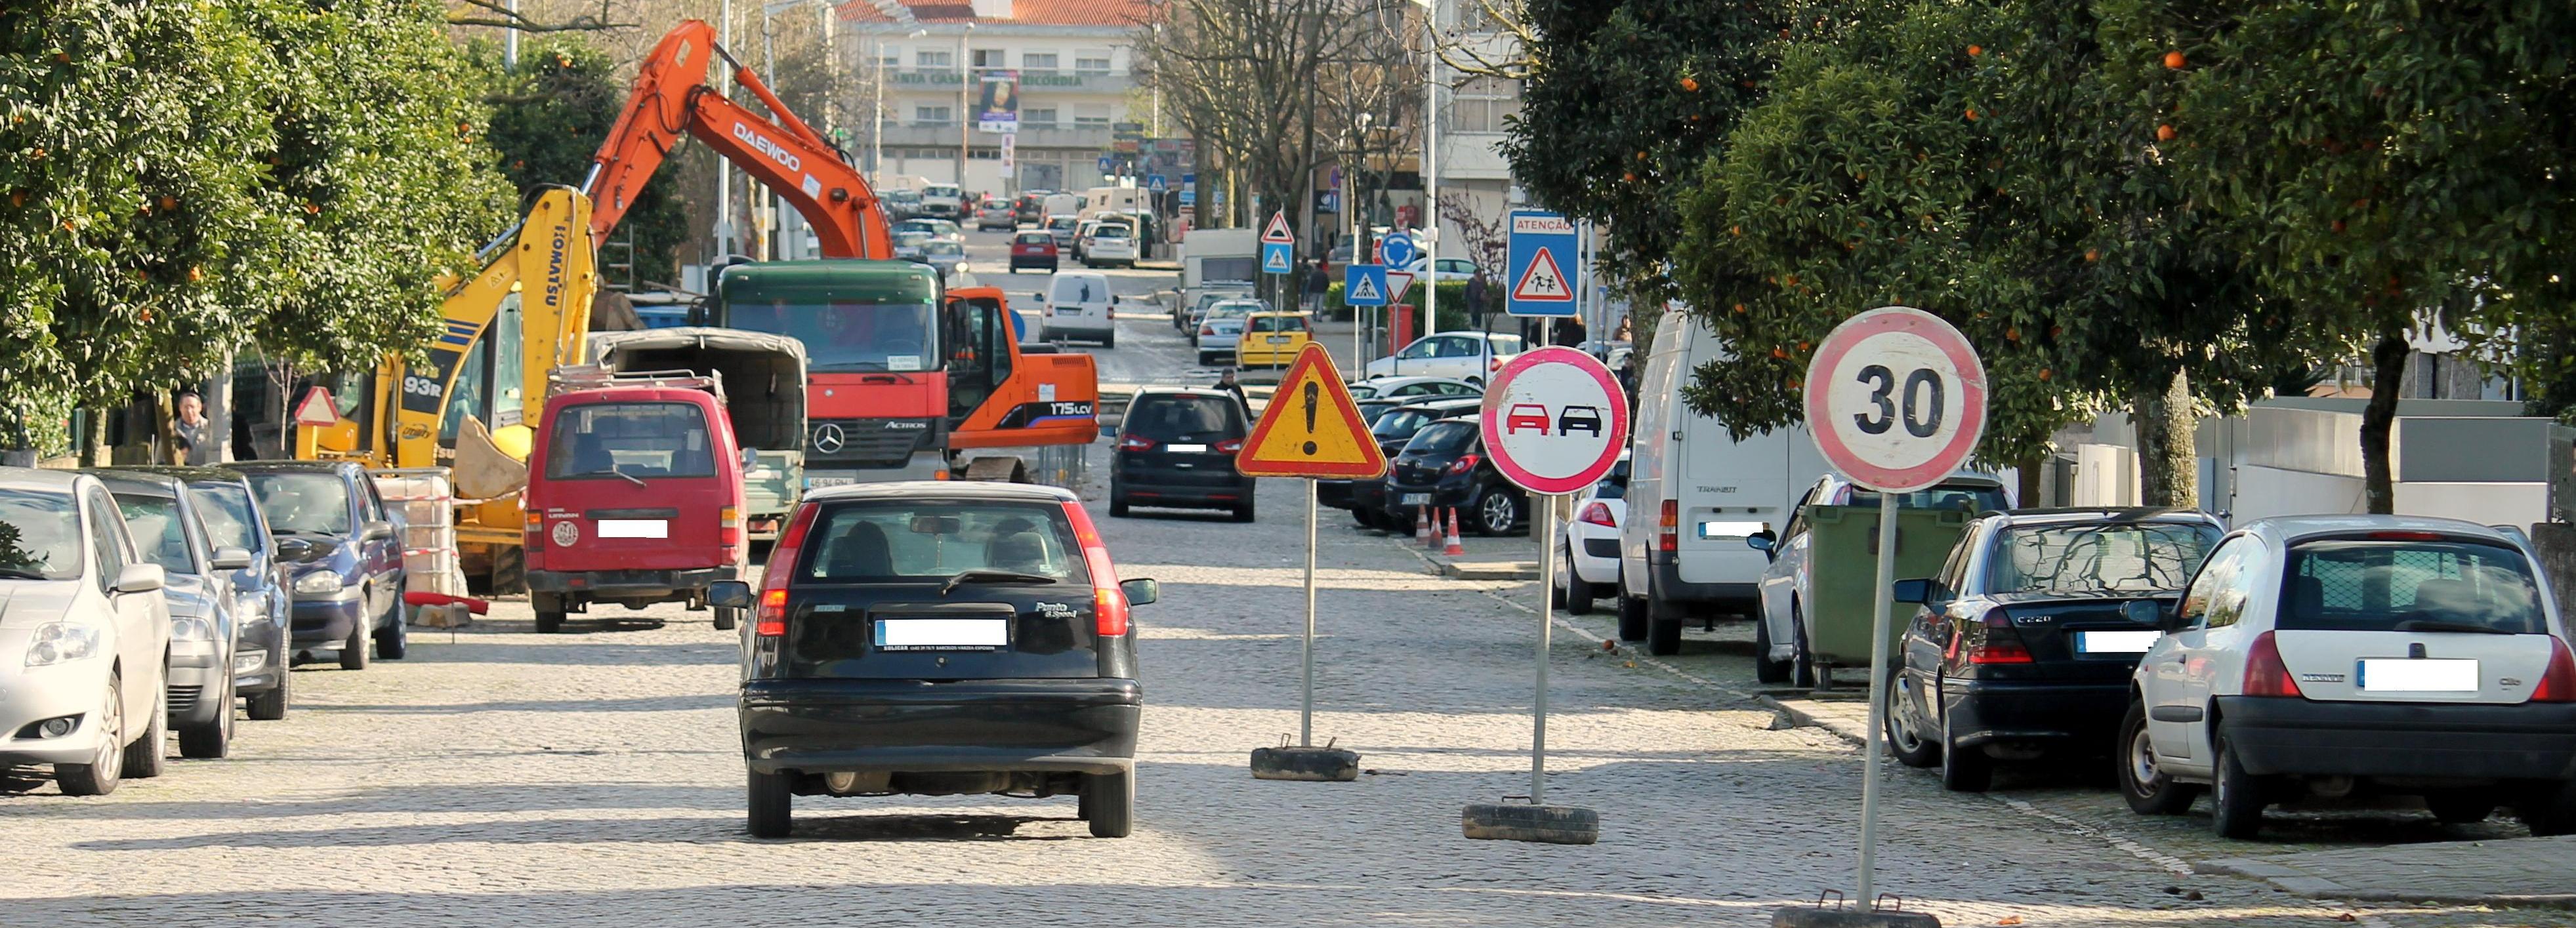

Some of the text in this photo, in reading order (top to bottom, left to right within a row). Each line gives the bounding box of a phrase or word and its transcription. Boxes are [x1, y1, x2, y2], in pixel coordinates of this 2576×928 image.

[734, 122, 800, 172] DAEWOO
[1516, 218, 1571, 232] ATENÇÃO
[545, 226, 566, 306] KOMATSU
[404, 376, 442, 397] 93R
[1853, 365, 1944, 437] 30
[1035, 602, 1068, 611] Punto
